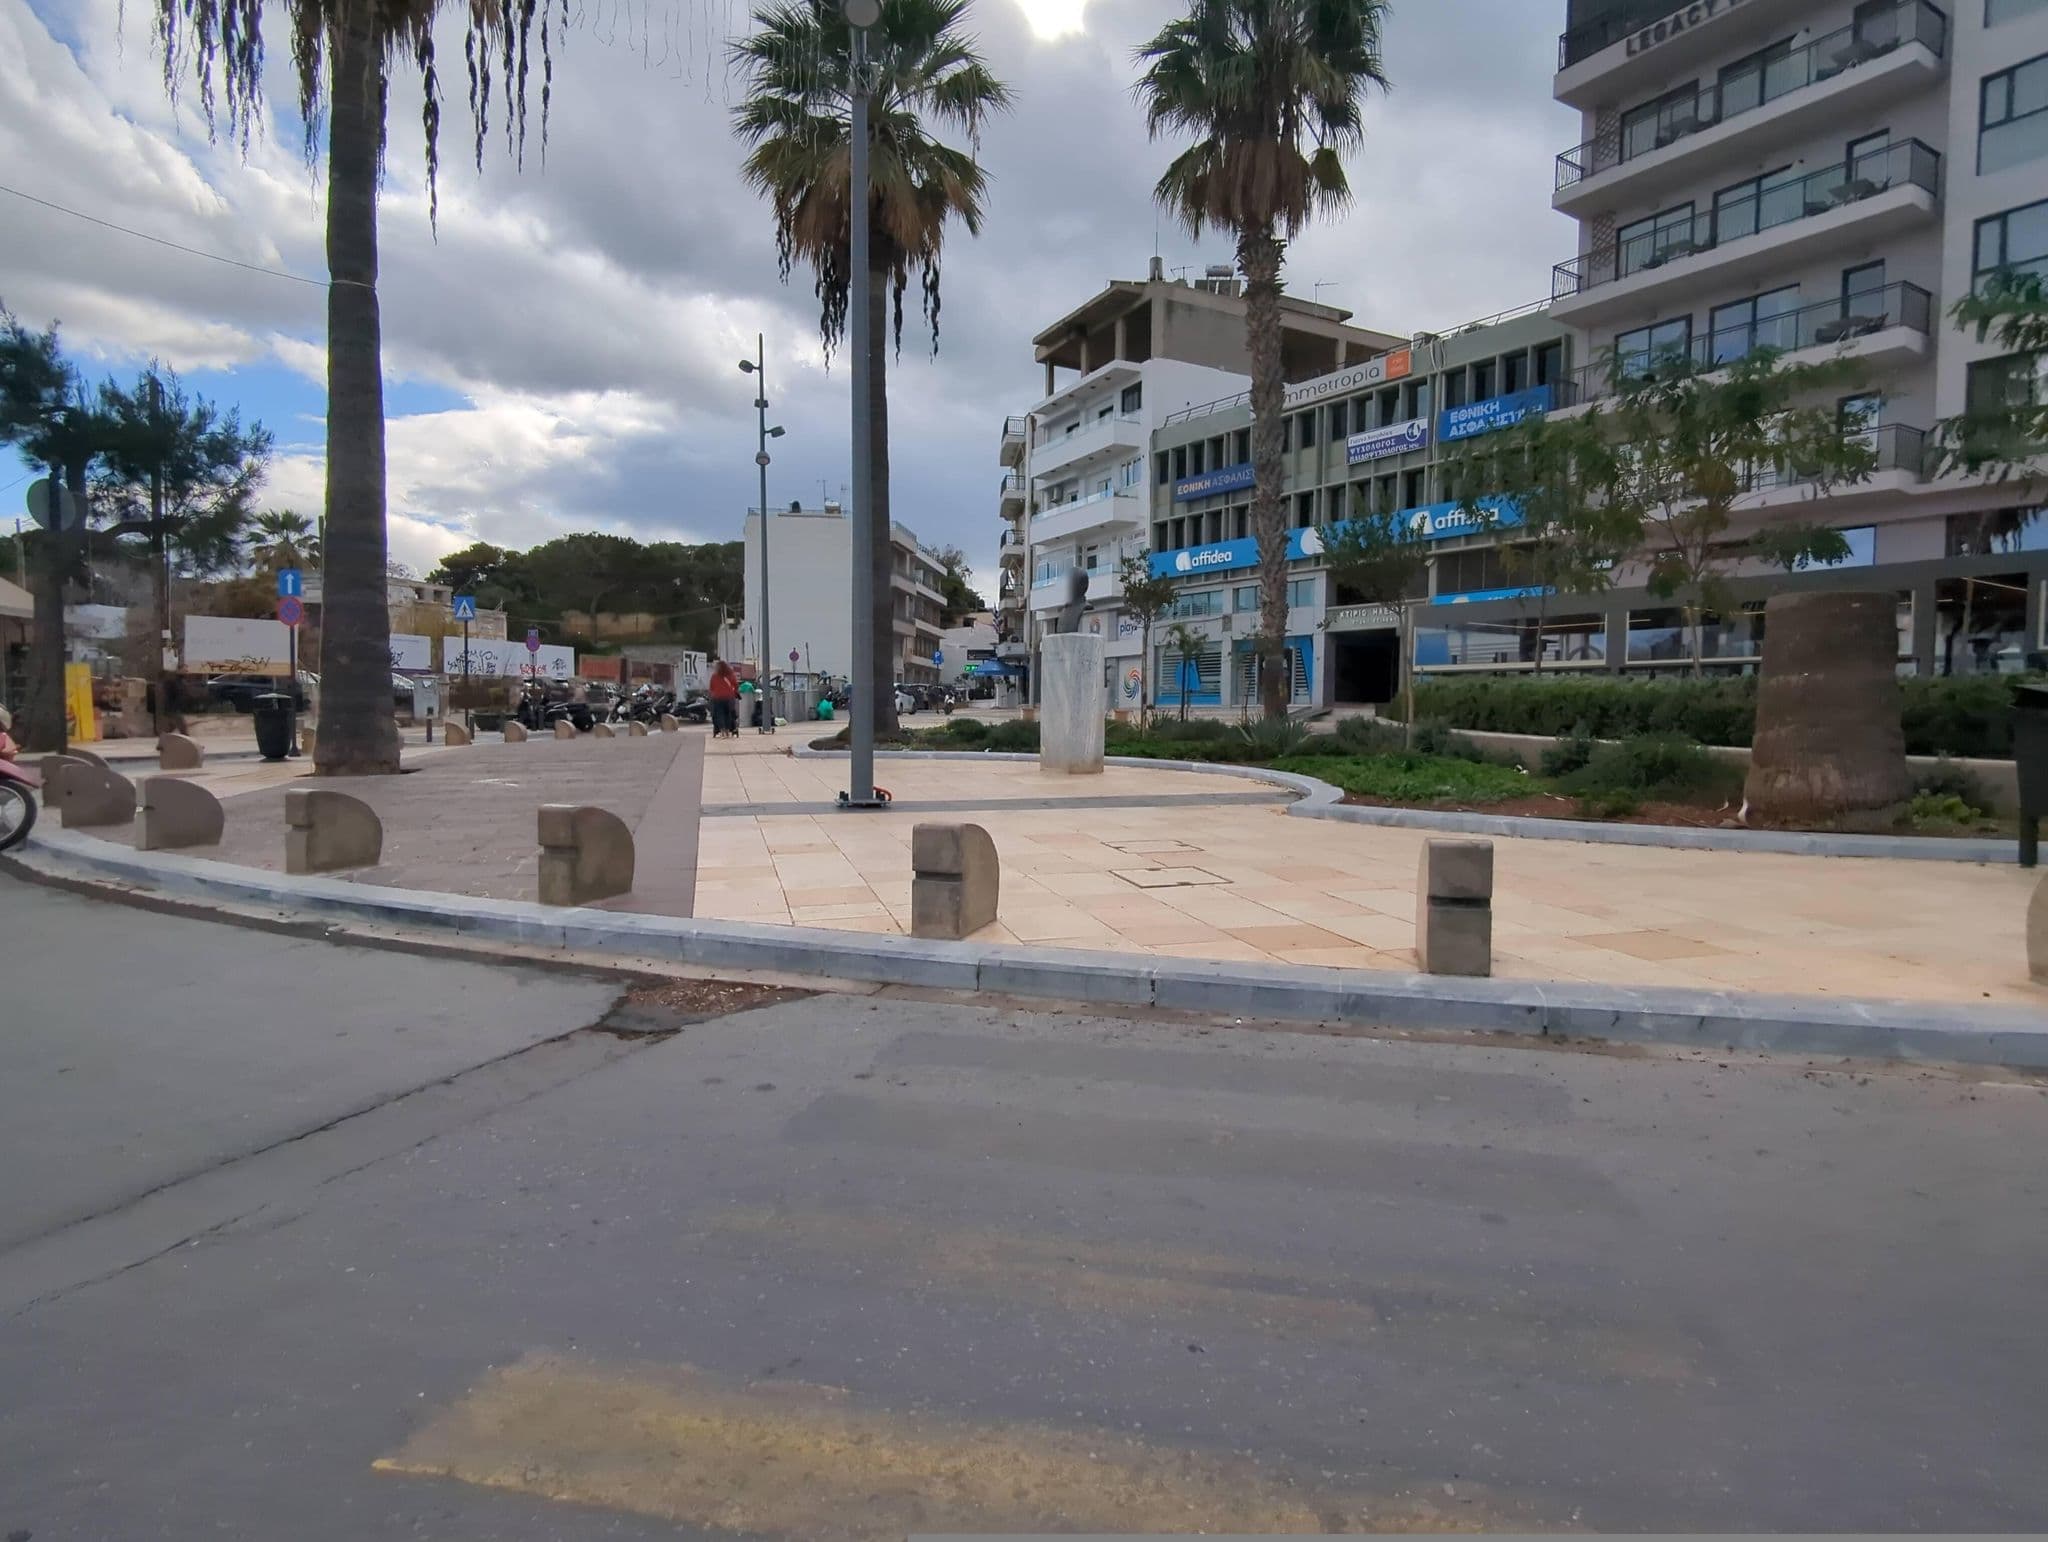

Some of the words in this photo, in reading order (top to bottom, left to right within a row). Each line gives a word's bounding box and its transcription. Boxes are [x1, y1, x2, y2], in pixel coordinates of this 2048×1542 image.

[1625, 0, 1717, 57] LEGACY
[1285, 365, 1380, 403] mmetropia
[1450, 400, 1500, 424] ΕΘΝΙΚΗ
[1350, 438, 1397, 455] ΨΥΧΟΛΟΓΟΣ
[1177, 479, 1211, 495] ΕΘΝΙΚΗ
[1191, 550, 1233, 567] affidea
